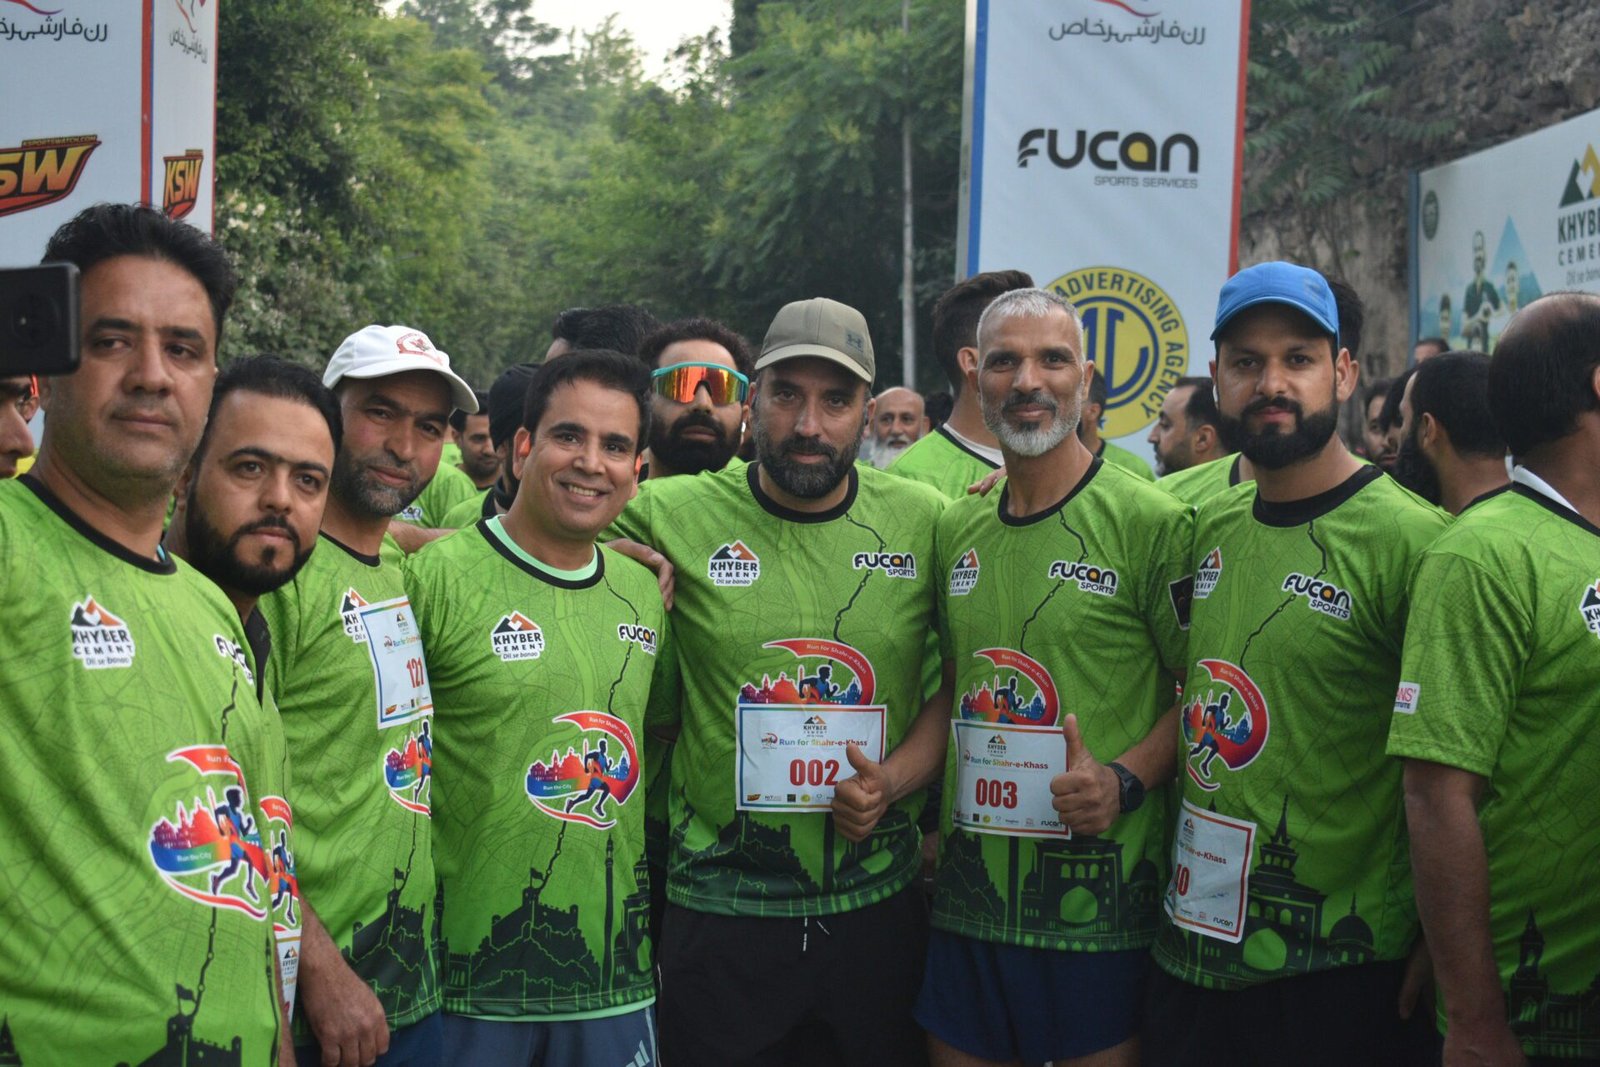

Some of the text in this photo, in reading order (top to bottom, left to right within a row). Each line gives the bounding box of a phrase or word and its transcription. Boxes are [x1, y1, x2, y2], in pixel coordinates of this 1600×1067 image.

[165, 158, 202, 207] KSW
[1094, 175, 1198, 189] SPORTS SERVICES
[1558, 206, 1600, 244] KHYB
[1558, 242, 1600, 266] CEME
[1054, 272, 1180, 334] ADVERTISING
[1140, 341, 1184, 418] AGENCY
[710, 561, 758, 572] KHYBER
[887, 568, 915, 577] SPORTS
[1080, 582, 1115, 595] SPORTS
[1310, 599, 1349, 618] SPORTS
[72, 629, 130, 643] KHYBER
[493, 632, 542, 645] KHYBER
[73, 644, 133, 656] CEMENT
[495, 643, 544, 653] CEMENT
[520, 651, 538, 659] banao
[407, 657, 424, 689] 121
[797, 738, 809, 746] for
[206, 754, 234, 763] Run fo
[971, 756, 981, 764] Run
[982, 757, 991, 765] for
[992, 758, 1049, 770] Shahr-e-Khass
[790, 759, 840, 787] 002
[976, 777, 1018, 809] 003
[177, 854, 187, 862] Run
[199, 852, 211, 861] City
